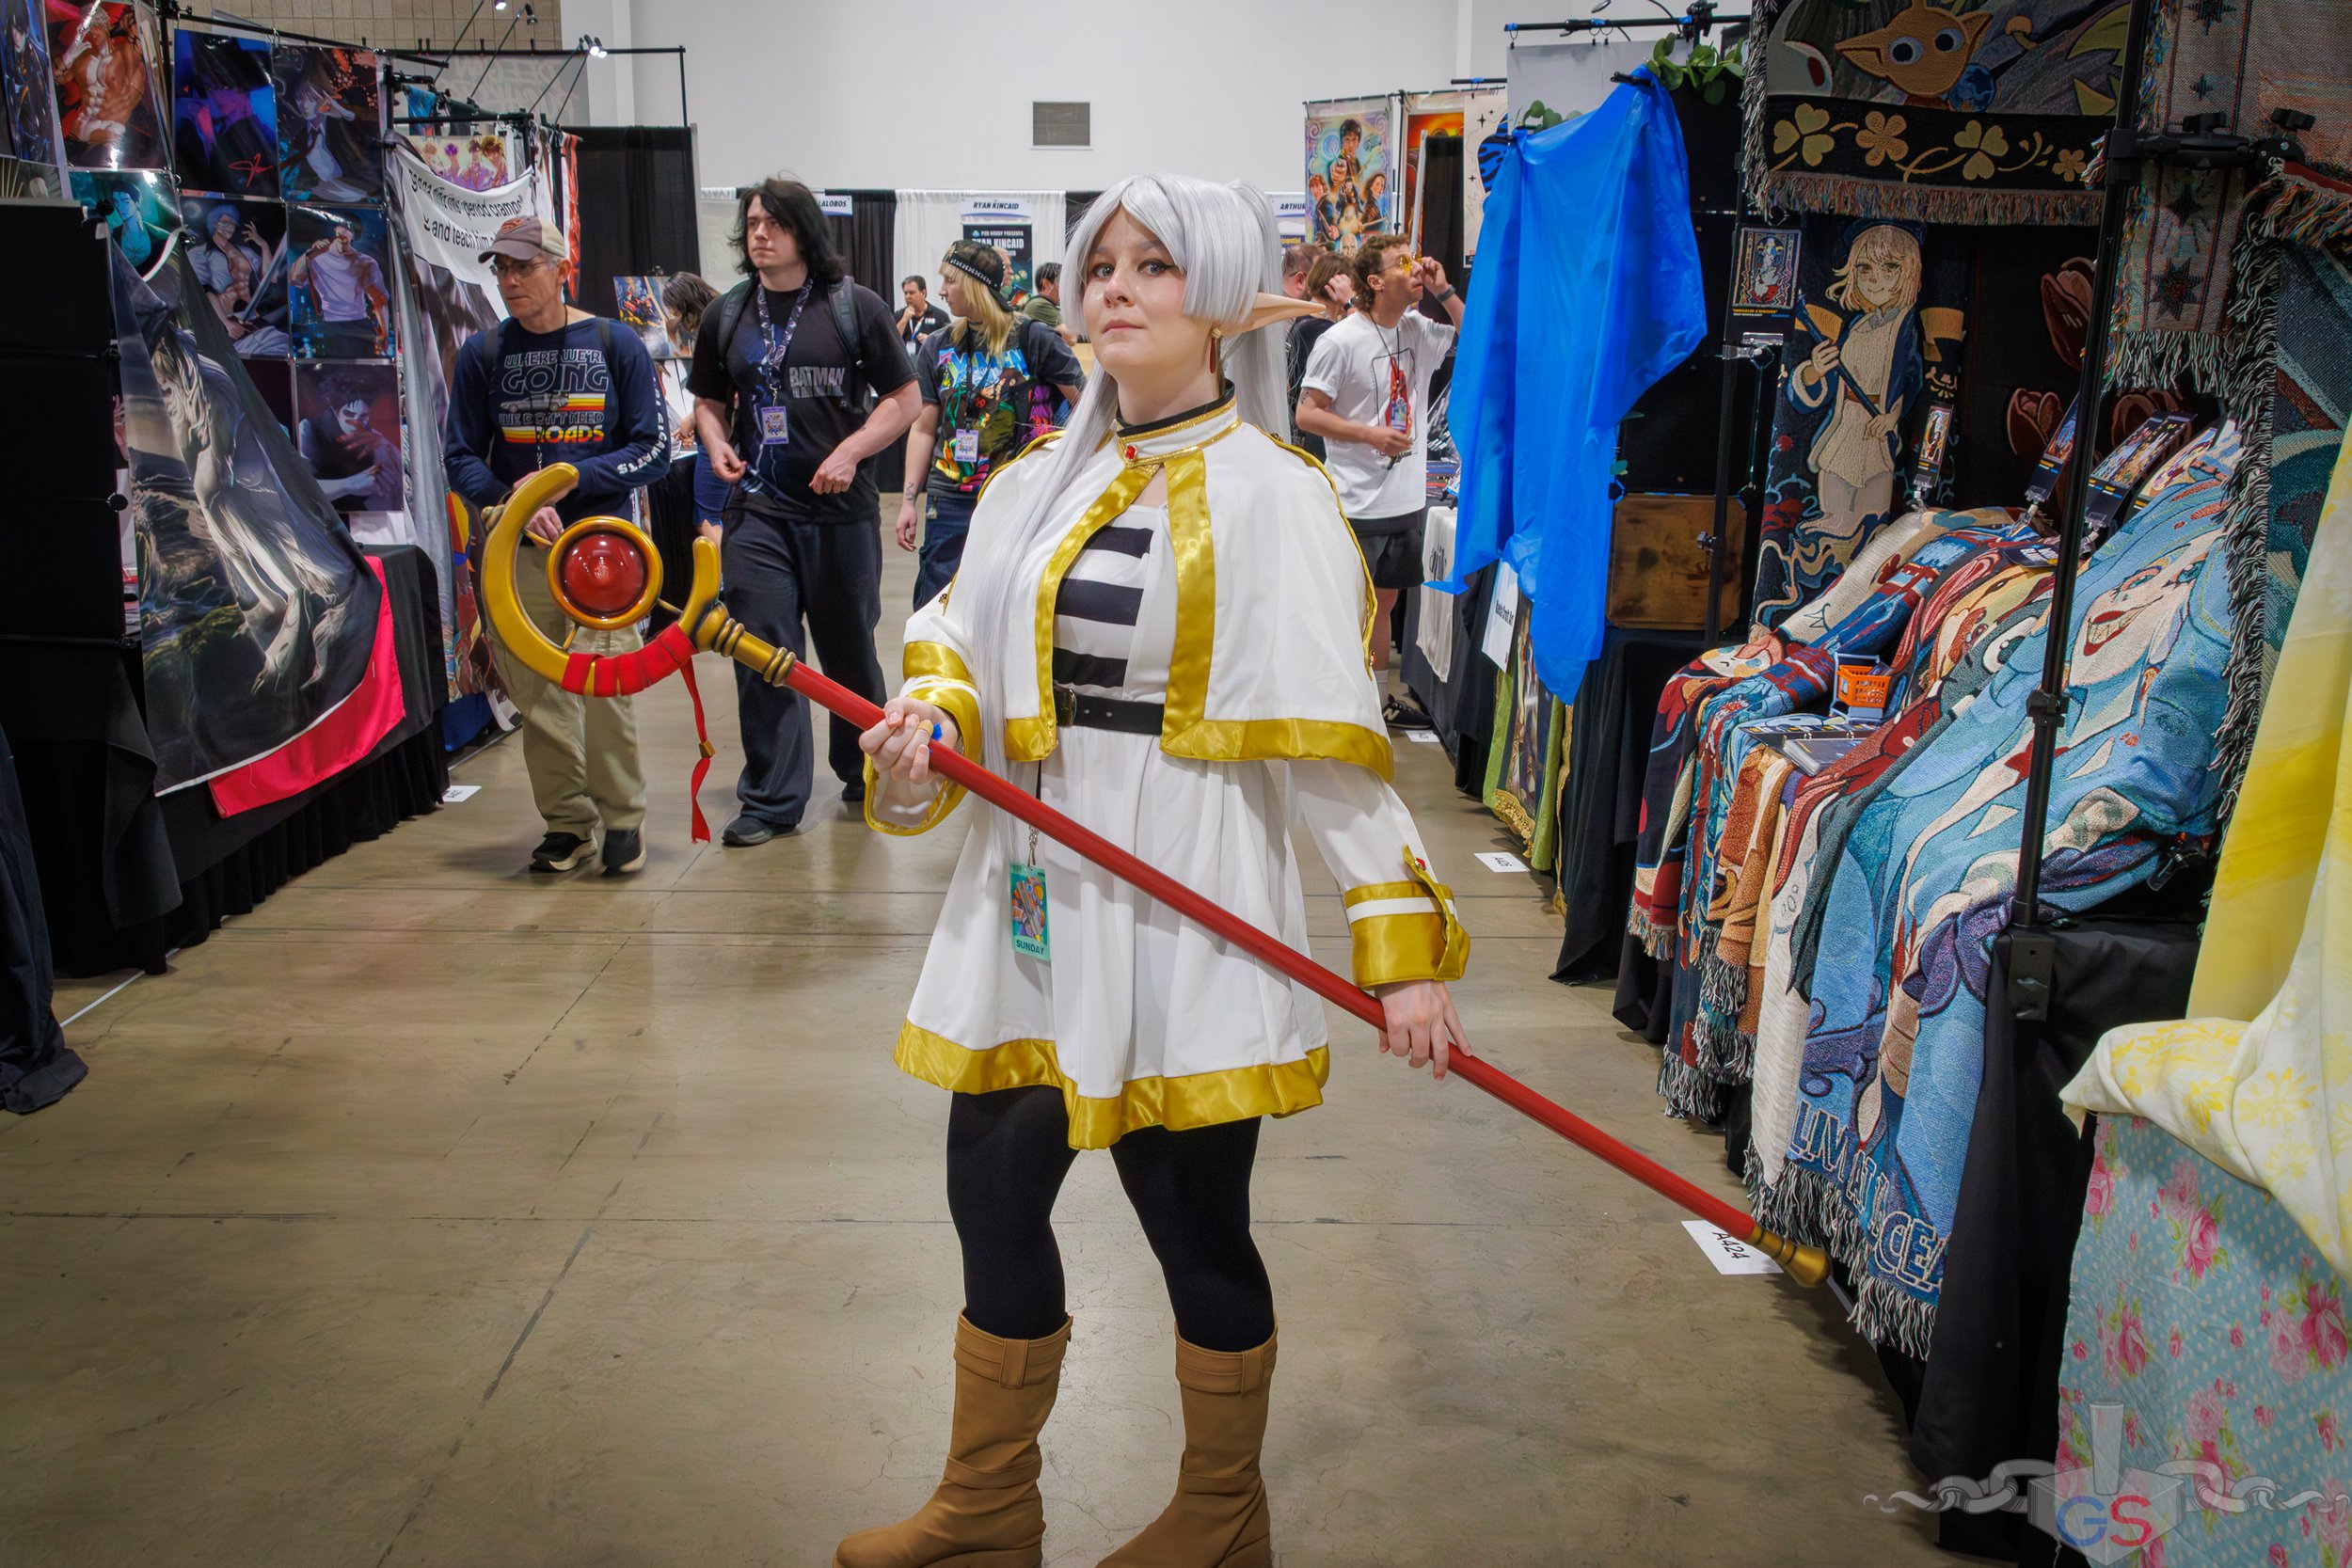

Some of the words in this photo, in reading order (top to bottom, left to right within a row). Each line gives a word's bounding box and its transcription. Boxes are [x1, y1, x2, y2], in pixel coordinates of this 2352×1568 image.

[432, 221, 450, 242] and
[452, 227, 475, 248] teach
[993, 238, 1025, 249] KINCAID
[503, 349, 559, 369] WHERE
[501, 363, 610, 395] GOING
[788, 366, 846, 388] BATMAN
[499, 412, 521, 425] WE
[522, 411, 566, 425] DON'T
[568, 411, 605, 424] NEED
[1016, 939, 1044, 956] SUNDAY
[1712, 1232, 1751, 1259] A424
